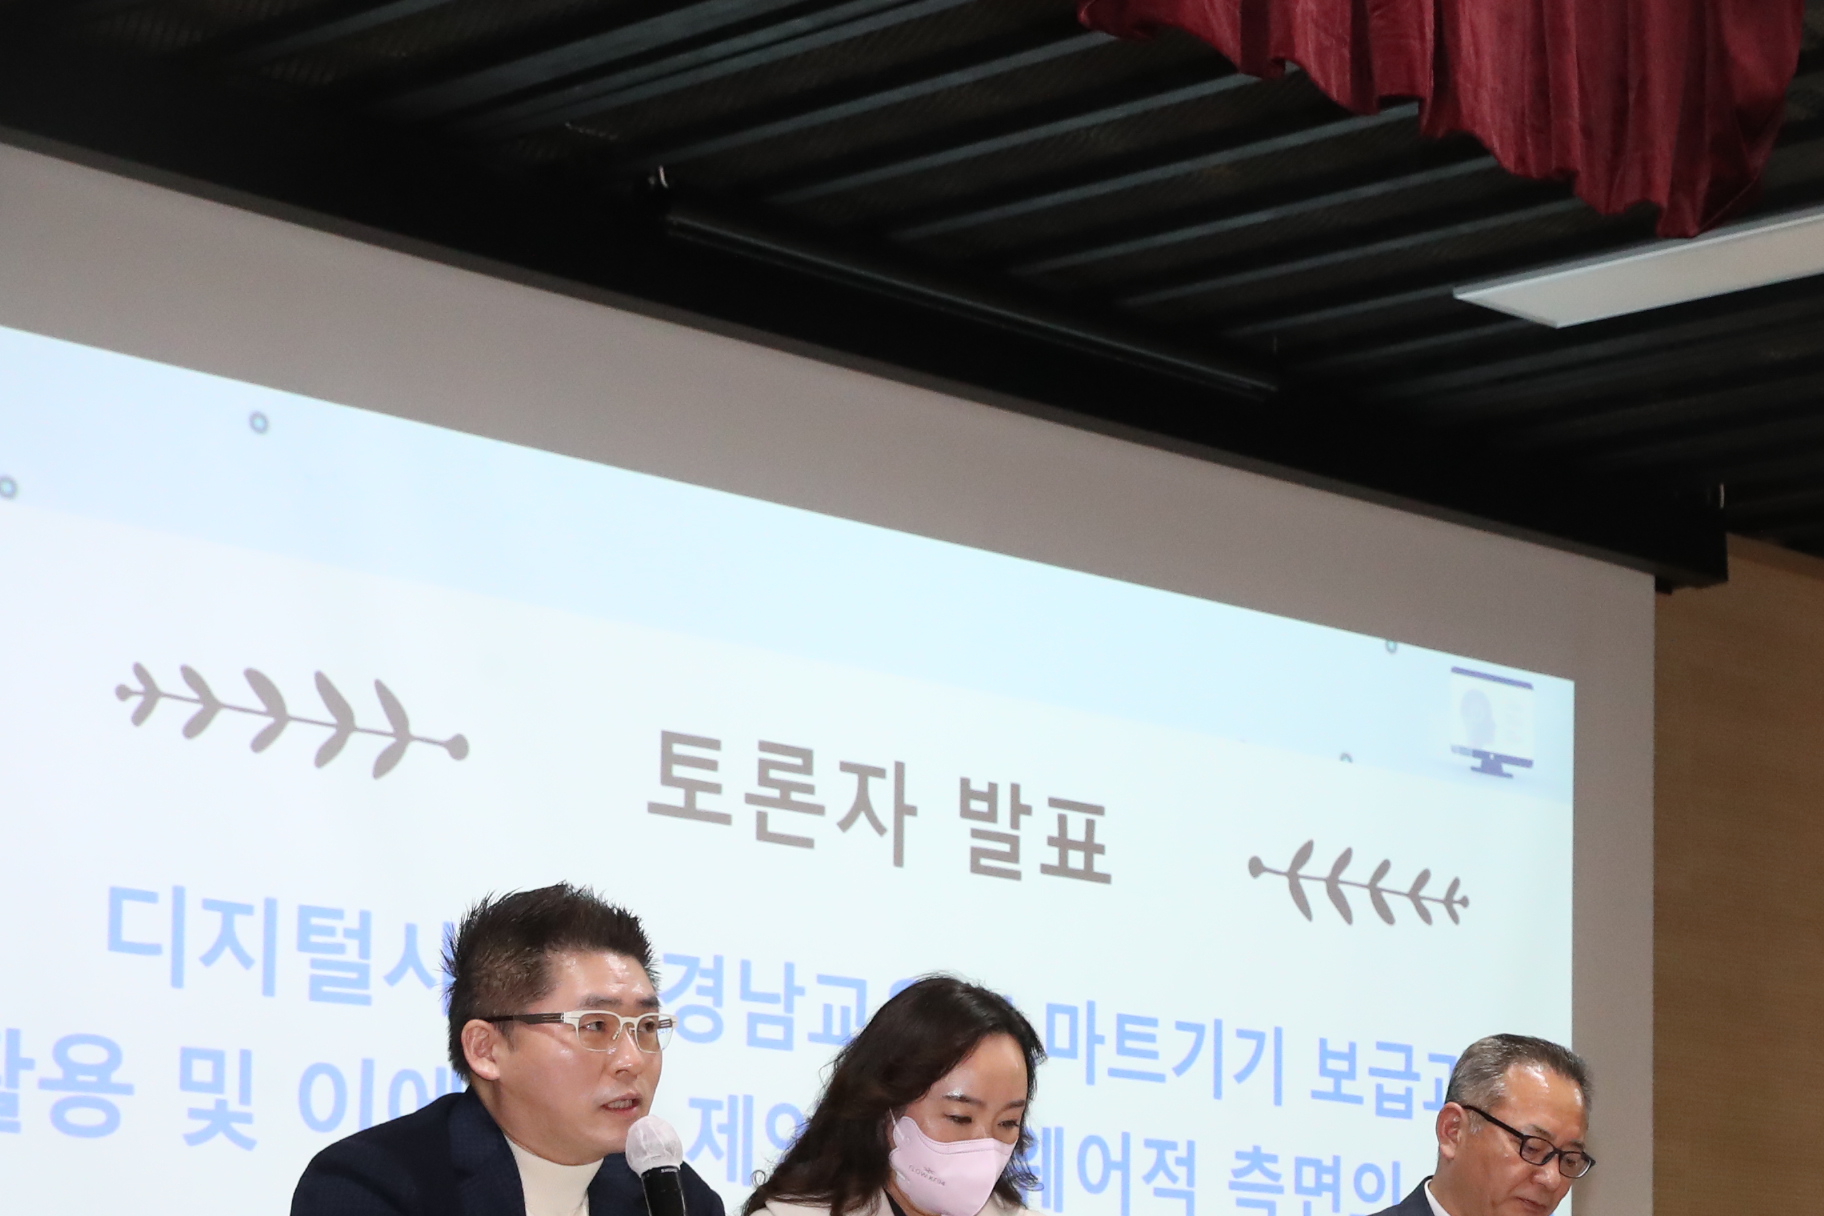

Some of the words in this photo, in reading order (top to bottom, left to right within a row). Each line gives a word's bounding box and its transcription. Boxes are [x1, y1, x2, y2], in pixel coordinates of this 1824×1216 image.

[647, 730, 918, 869] 토론자
[959, 777, 1112, 885] 발표
[107, 885, 457, 1016] 디지털시
[658, 952, 905, 1052] 경남교
[1042, 1000, 1284, 1107] 마트기기
[179, 1046, 258, 1152] 및
